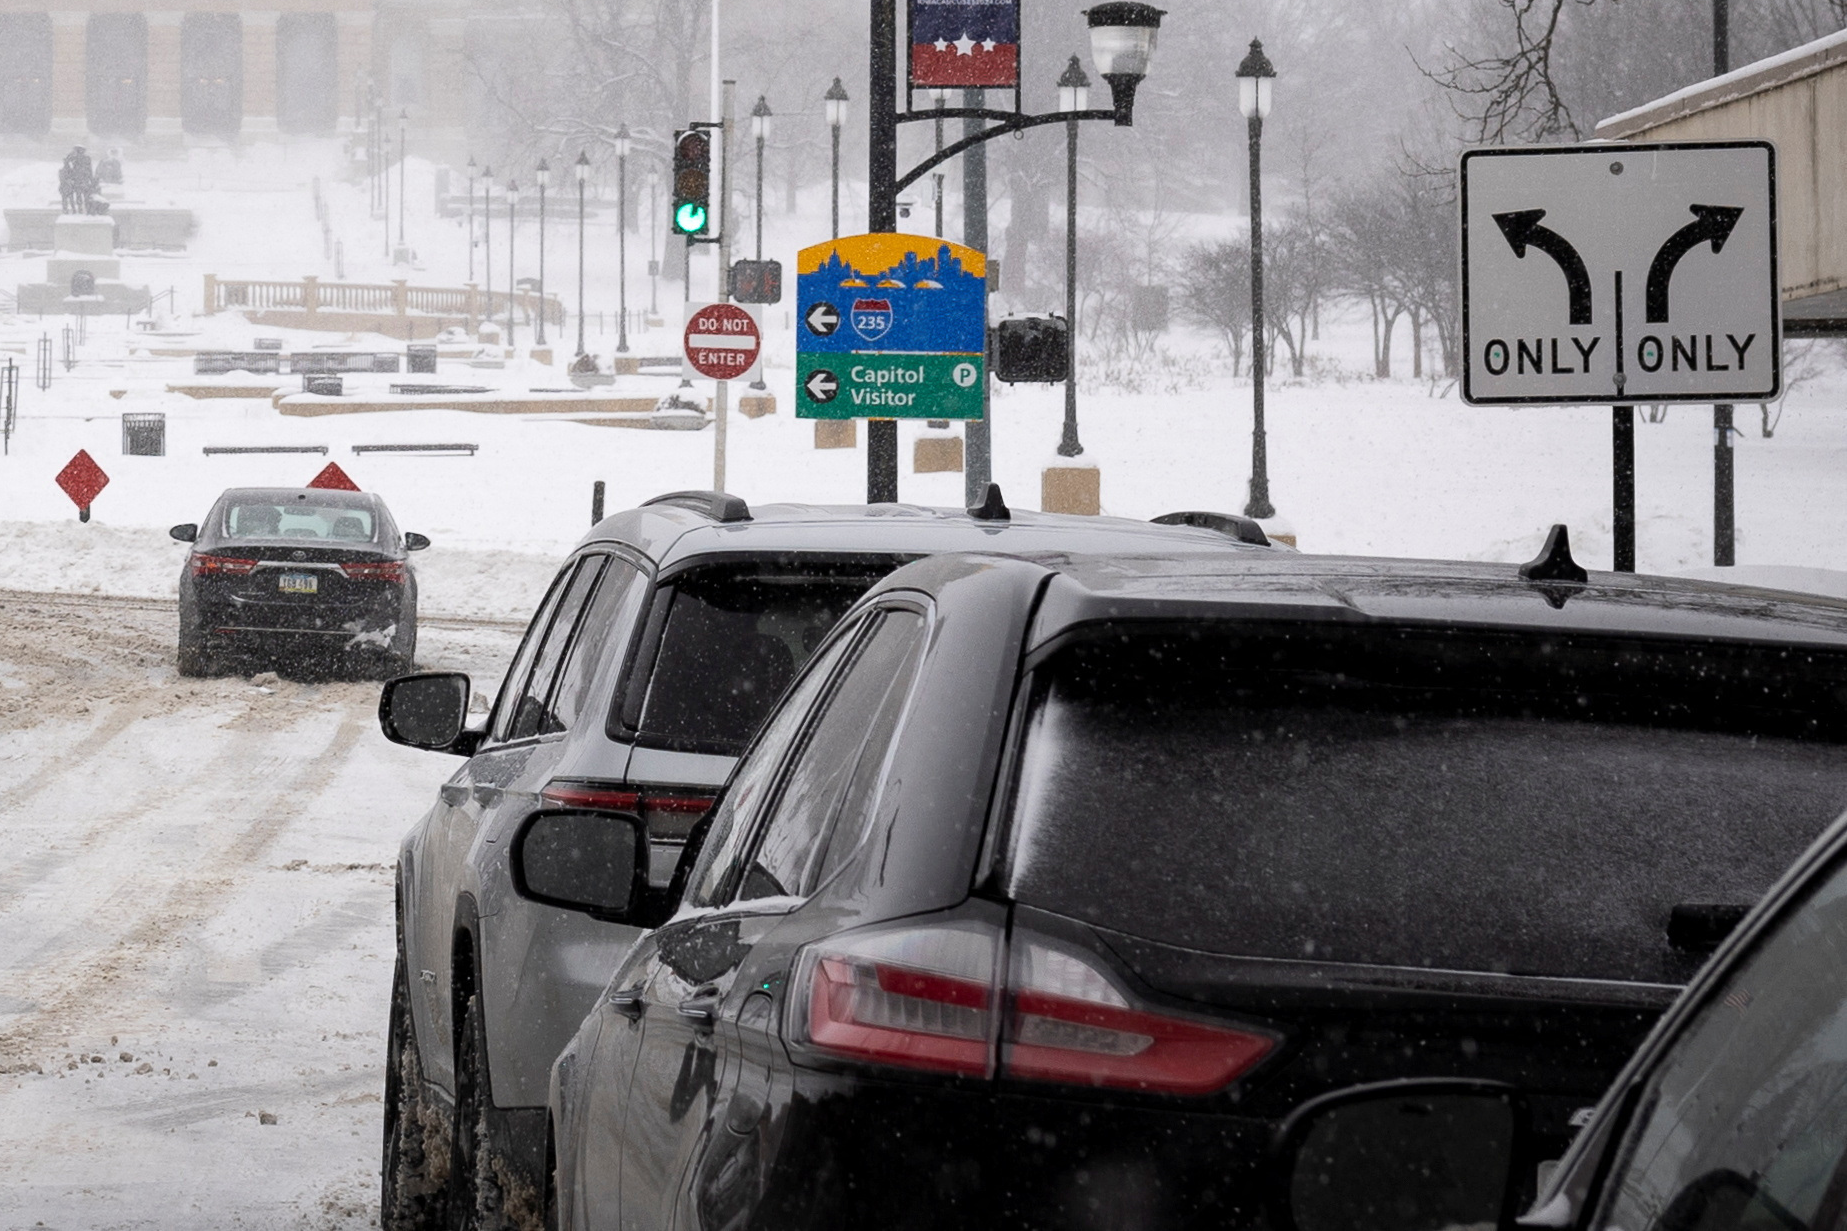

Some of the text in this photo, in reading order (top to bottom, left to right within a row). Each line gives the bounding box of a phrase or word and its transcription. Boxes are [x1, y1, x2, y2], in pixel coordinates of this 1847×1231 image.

[699, 317, 749, 332] DO NOT
[857, 316, 885, 330] 235
[698, 352, 746, 366] ENTER
[1483, 336, 1601, 376] ONLY
[1637, 333, 1756, 373] ONLY
[851, 365, 924, 385] Capitol
[959, 367, 971, 383] P
[851, 387, 916, 406] Visitor
